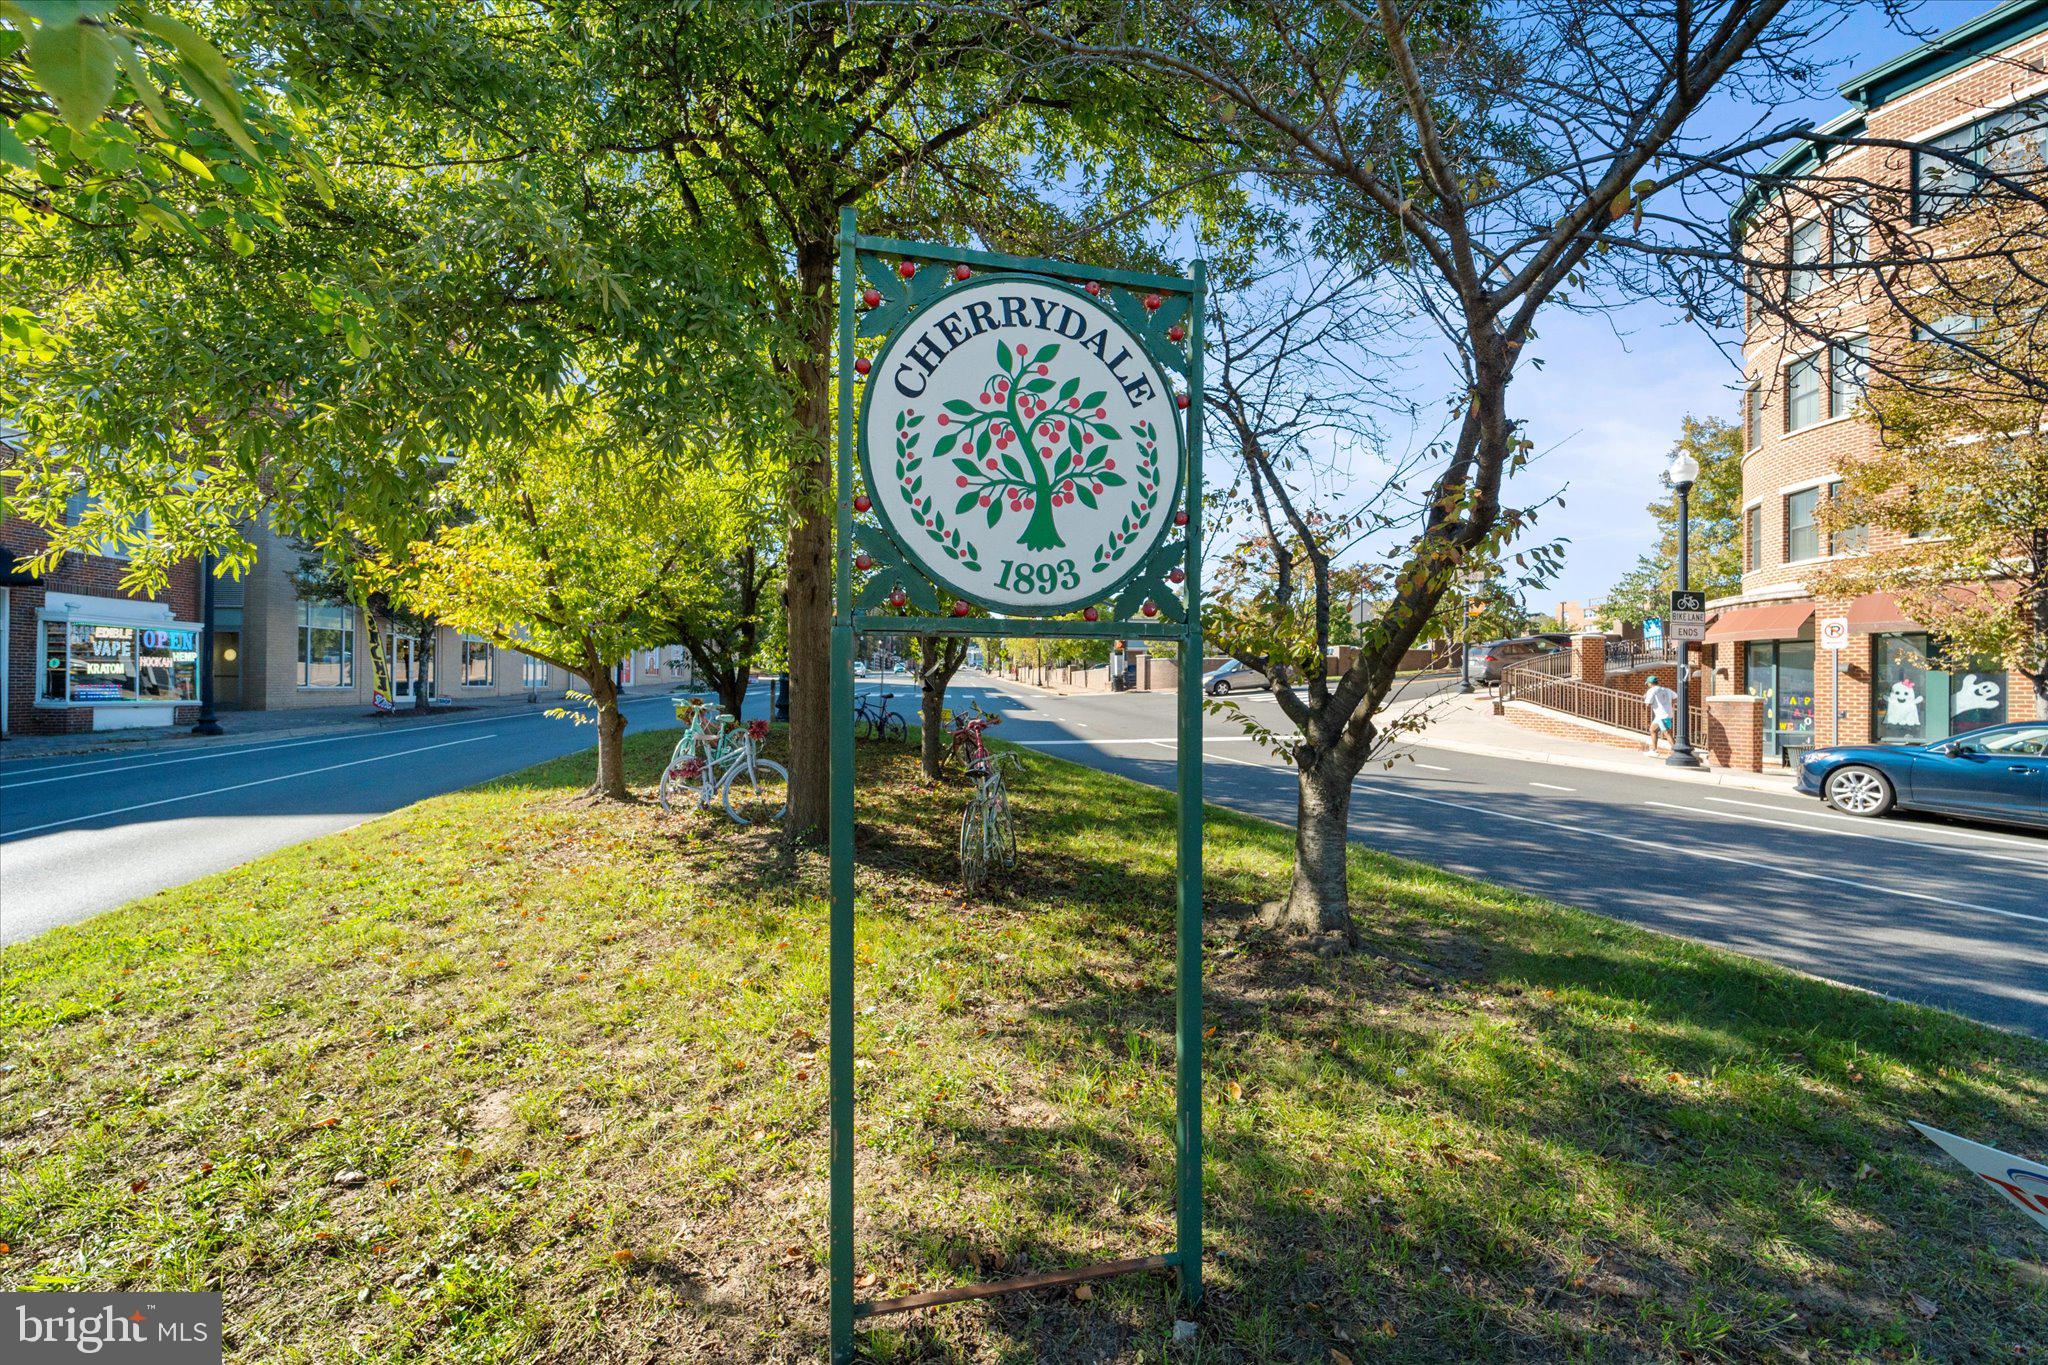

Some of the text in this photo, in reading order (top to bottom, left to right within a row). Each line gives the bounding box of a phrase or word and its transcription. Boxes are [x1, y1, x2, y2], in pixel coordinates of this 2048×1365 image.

[894, 296, 1156, 409] CHERRYDALE
[993, 558, 1081, 595] 1893
[1672, 612, 1704, 622] BIKE LANE
[95, 626, 133, 639] EDIBLE
[1678, 628, 1699, 637] ENDS
[143, 630, 194, 650] OPEN
[92, 640, 131, 657] VAPE
[172, 652, 197, 662] HEMP
[86, 663, 125, 675] KRATOM
